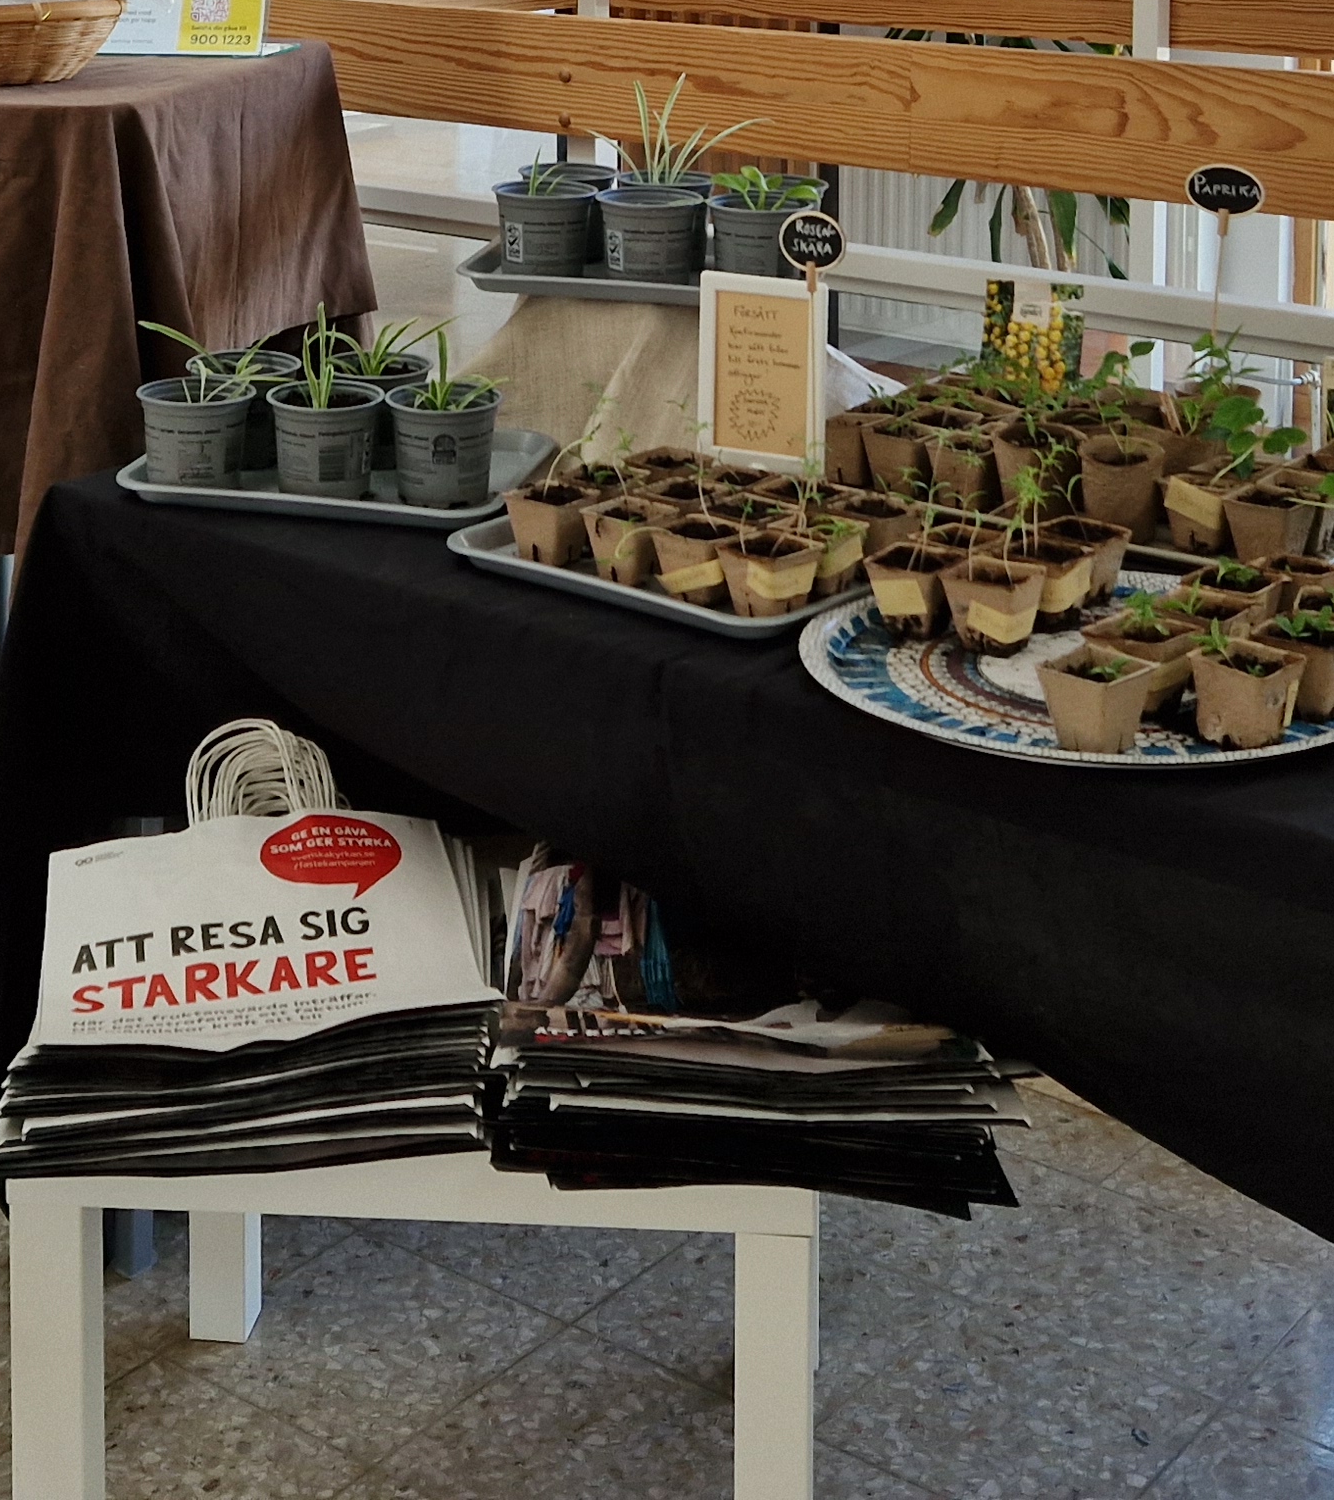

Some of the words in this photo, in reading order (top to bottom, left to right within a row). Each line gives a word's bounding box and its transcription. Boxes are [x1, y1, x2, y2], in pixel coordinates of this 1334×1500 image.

[190, 34, 218, 45] 900
[222, 34, 251, 45] 1223
[1193, 173, 1260, 200] PAPRIKA
[792, 238, 832, 257] SKÄRA
[291, 829, 308, 841] GE
[311, 826, 331, 836] EN
[334, 825, 369, 837] GÅVA
[270, 843, 303, 855] SOM
[305, 837, 334, 848] GER
[338, 837, 392, 848] STYRKA
[72, 932, 153, 974] ATT
[170, 915, 284, 957] RESA
[299, 906, 370, 941] SIG
[71, 946, 377, 1014] STARKARE
